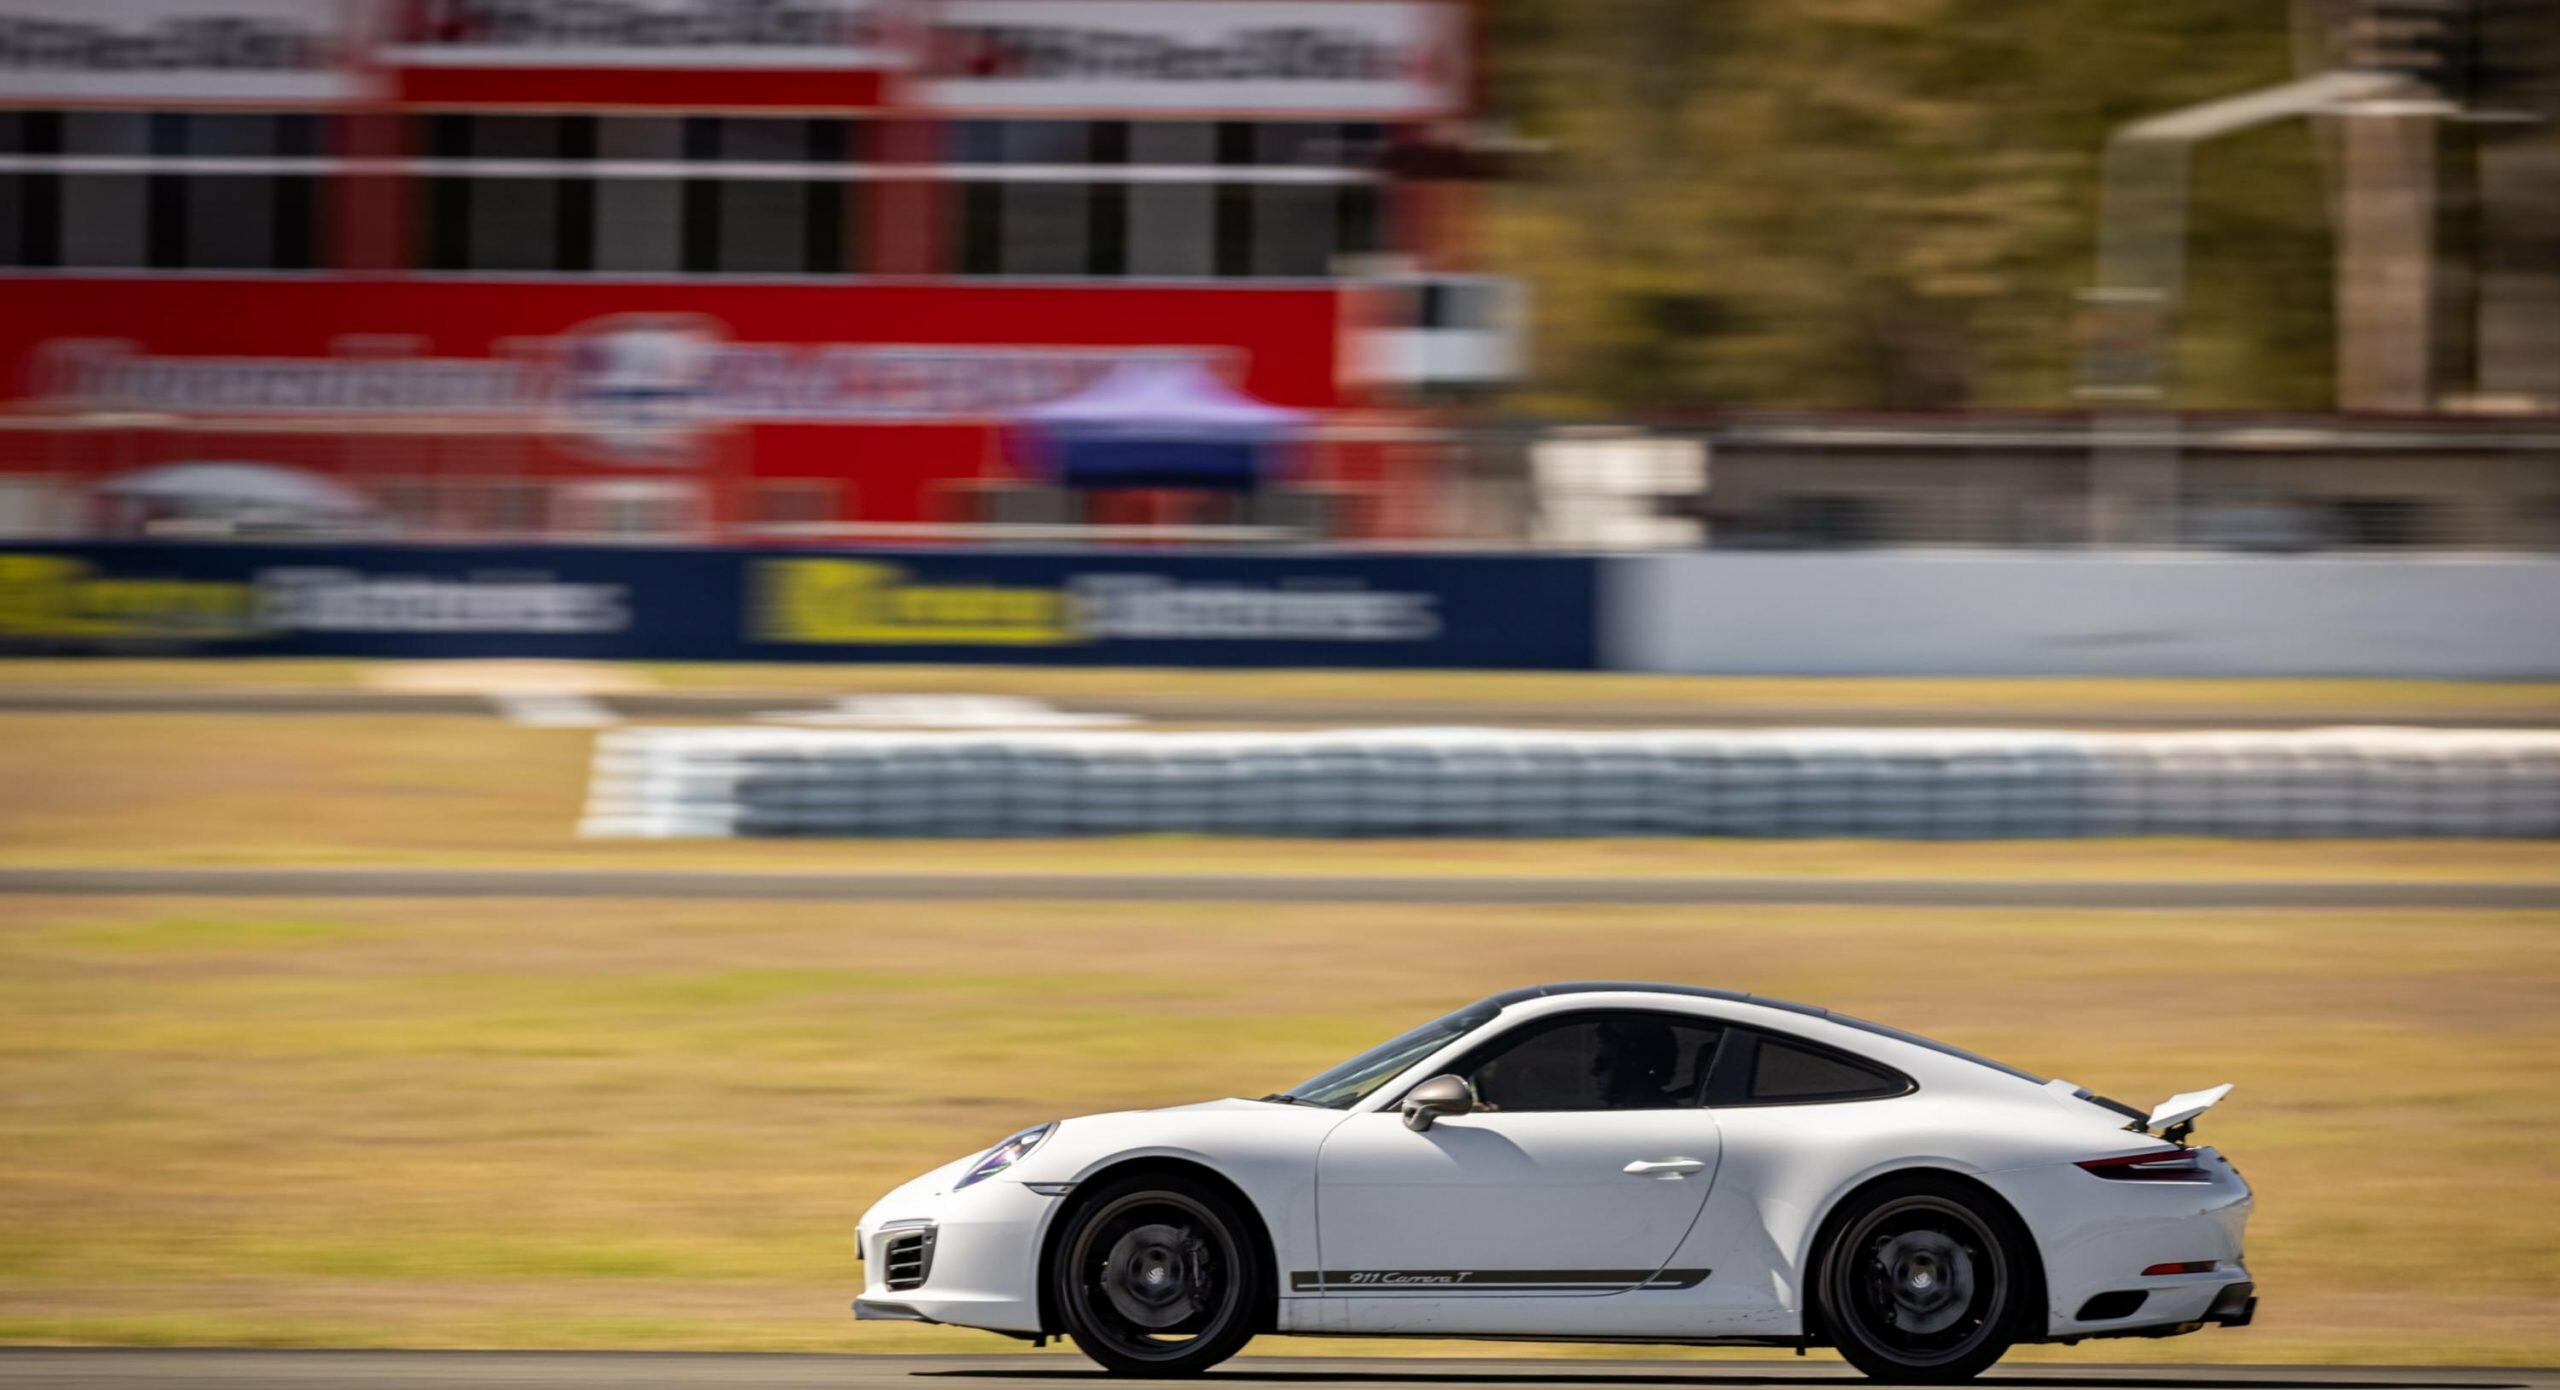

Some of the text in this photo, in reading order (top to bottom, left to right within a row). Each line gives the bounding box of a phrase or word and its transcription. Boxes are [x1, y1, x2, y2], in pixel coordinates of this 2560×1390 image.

[1349, 1272, 1473, 1283] 911 Carrera T
